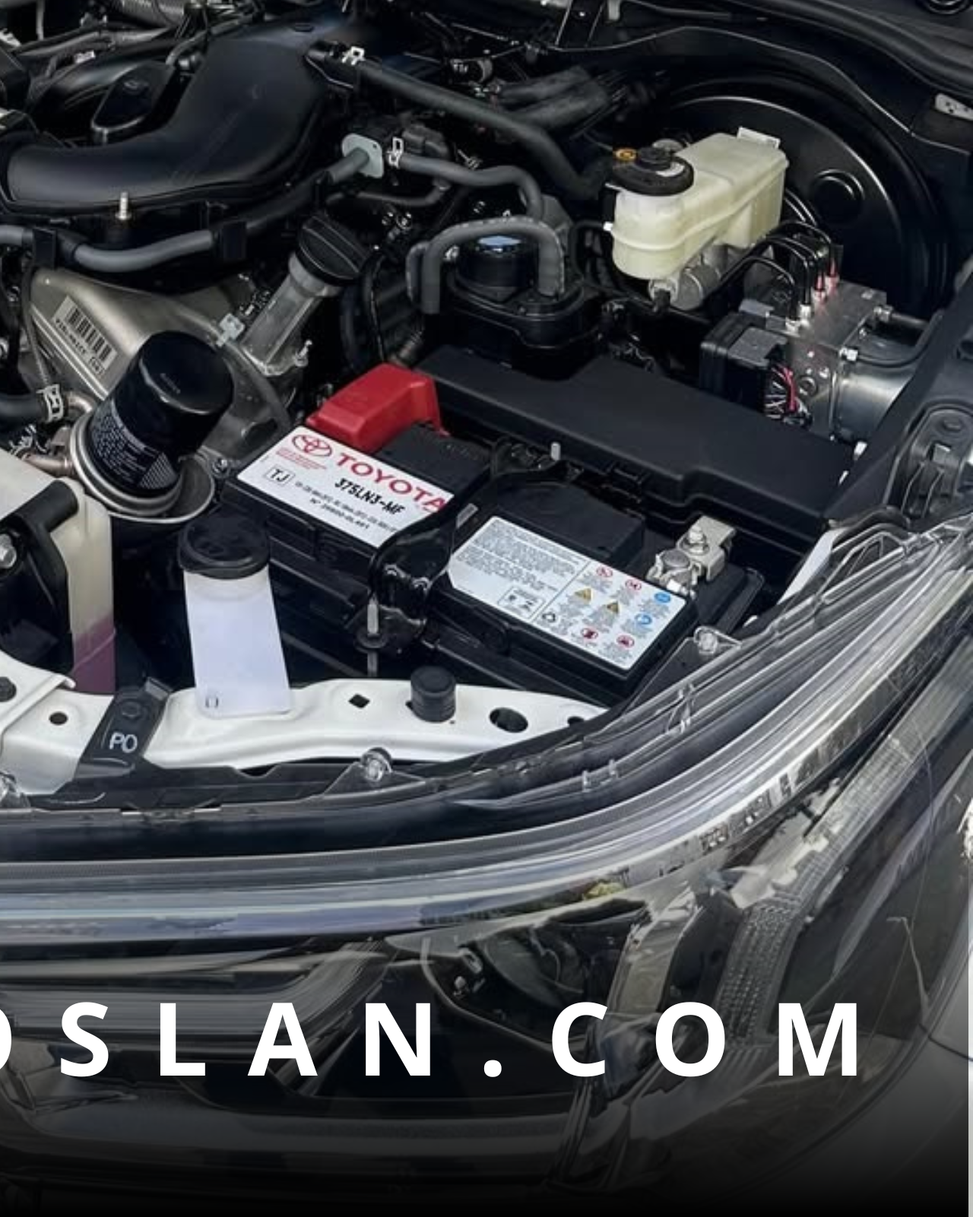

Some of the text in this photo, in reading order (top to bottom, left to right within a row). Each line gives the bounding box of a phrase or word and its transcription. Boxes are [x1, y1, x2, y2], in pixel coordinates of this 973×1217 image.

[271, 468, 290, 482] TJ
[332, 452, 447, 510] TOYOTA
[334, 478, 406, 515] 375LN3-MF
